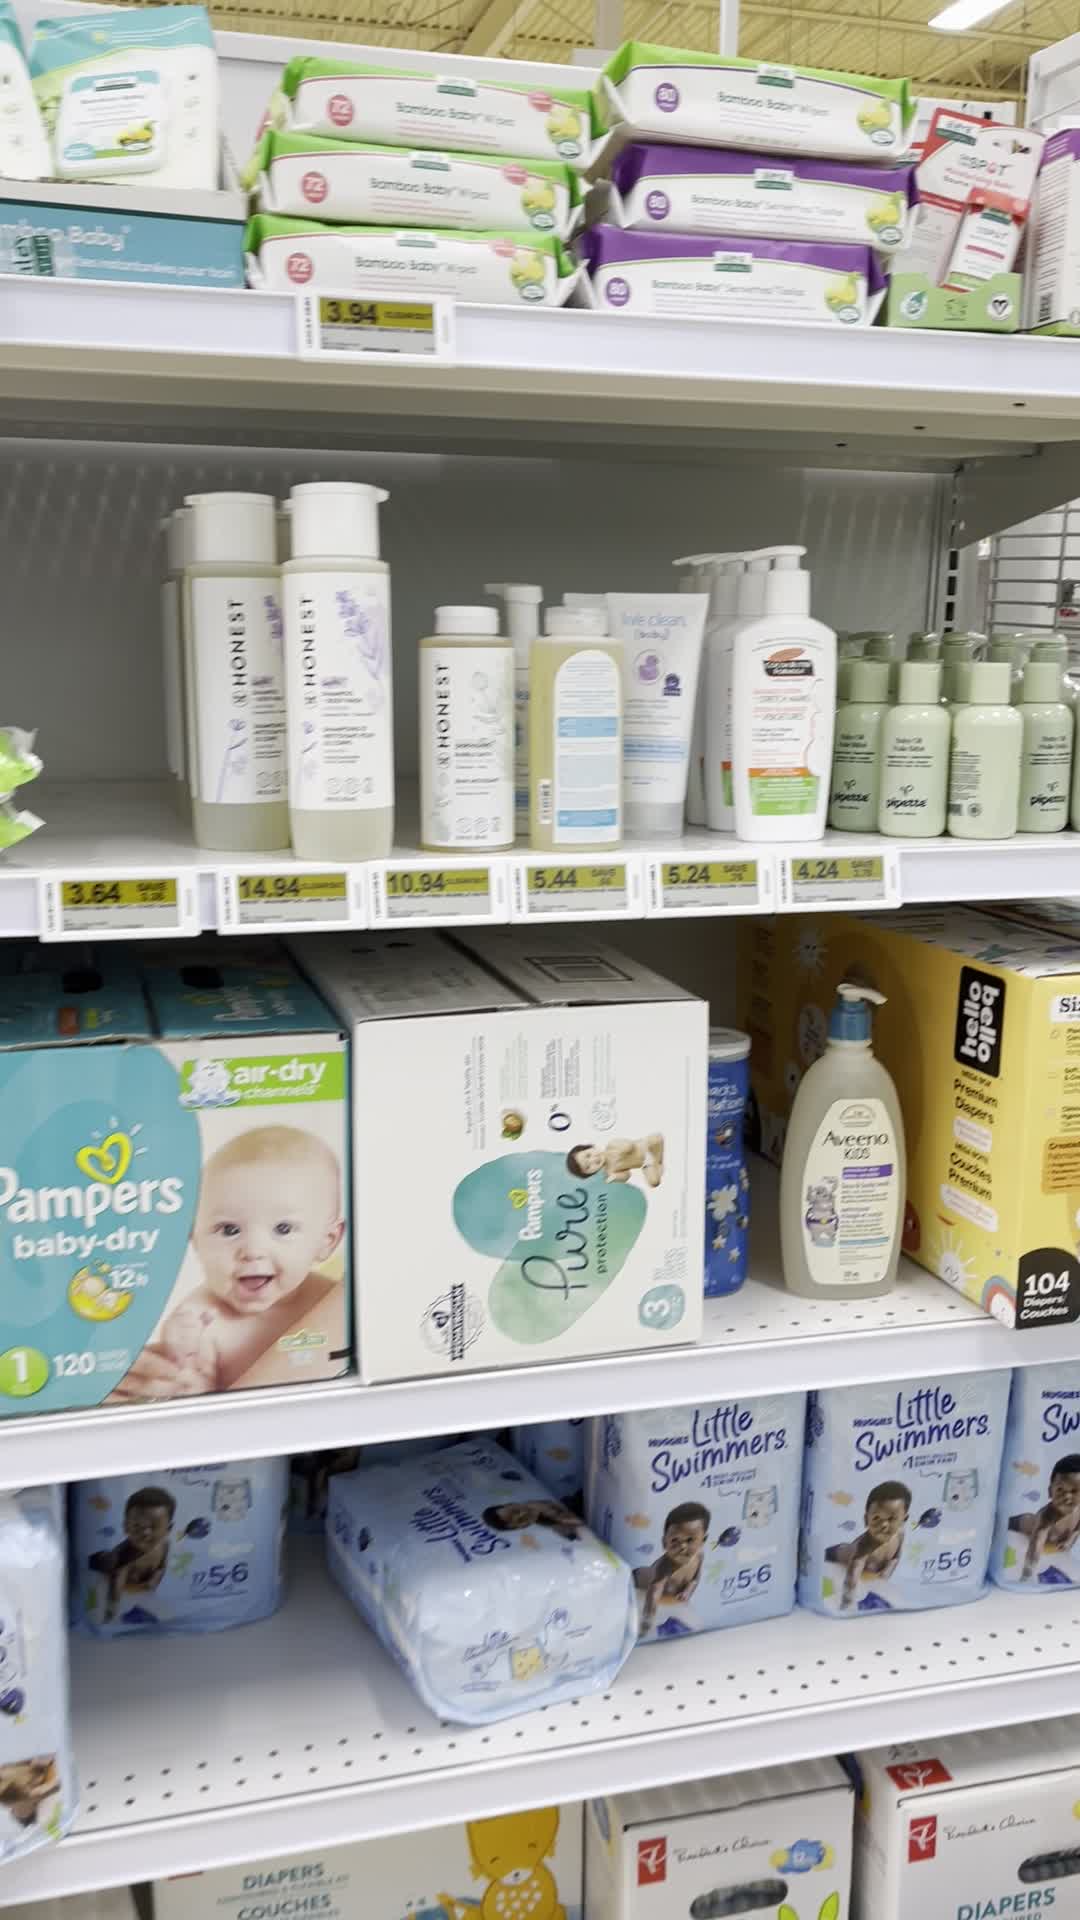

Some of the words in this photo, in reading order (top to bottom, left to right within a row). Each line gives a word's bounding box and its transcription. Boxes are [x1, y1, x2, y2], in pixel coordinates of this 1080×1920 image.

[368, 177, 420, 194] Bamboo
[354, 256, 408, 271] Bamboo
[327, 301, 378, 324] 3.94
[228, 596, 248, 686] HONEST
[300, 593, 317, 687] HONEST
[435, 664, 450, 748] HONEST
[387, 872, 446, 893] 10.94
[534, 869, 577, 889] 5.44
[668, 864, 711, 884] 5.24
[797, 861, 839, 880] 4.24
[69, 883, 121, 904] 3.64
[239, 876, 300, 898] 14.94
[958, 979, 983, 1059] hello
[1060, 996, 1080, 1014] Si
[976, 983, 1002, 1064] bello
[233, 1057, 328, 1086] air-dry
[822, 1130, 890, 1148] Aveeno
[518, 1168, 544, 1242] Pampers
[13, 1225, 161, 1260] baby-dry
[520, 1187, 590, 1301] Pure
[597, 1192, 609, 1275] protection
[1023, 1270, 1071, 1297] 104
[645, 1299, 671, 1318] 3
[1020, 1306, 1070, 1321] Couches
[11, 1351, 28, 1383] 1
[53, 1352, 96, 1377] 120
[853, 1416, 894, 1428] HUGGIES
[895, 1386, 956, 1430] Little
[692, 1403, 754, 1448] Little
[854, 1413, 990, 1472] Swimmers
[651, 1428, 787, 1493] Swimmers
[242, 1861, 325, 1890] DIAPERS
[236, 1893, 332, 1920] COUCHES
[957, 1886, 1057, 1920] DIAPERS
